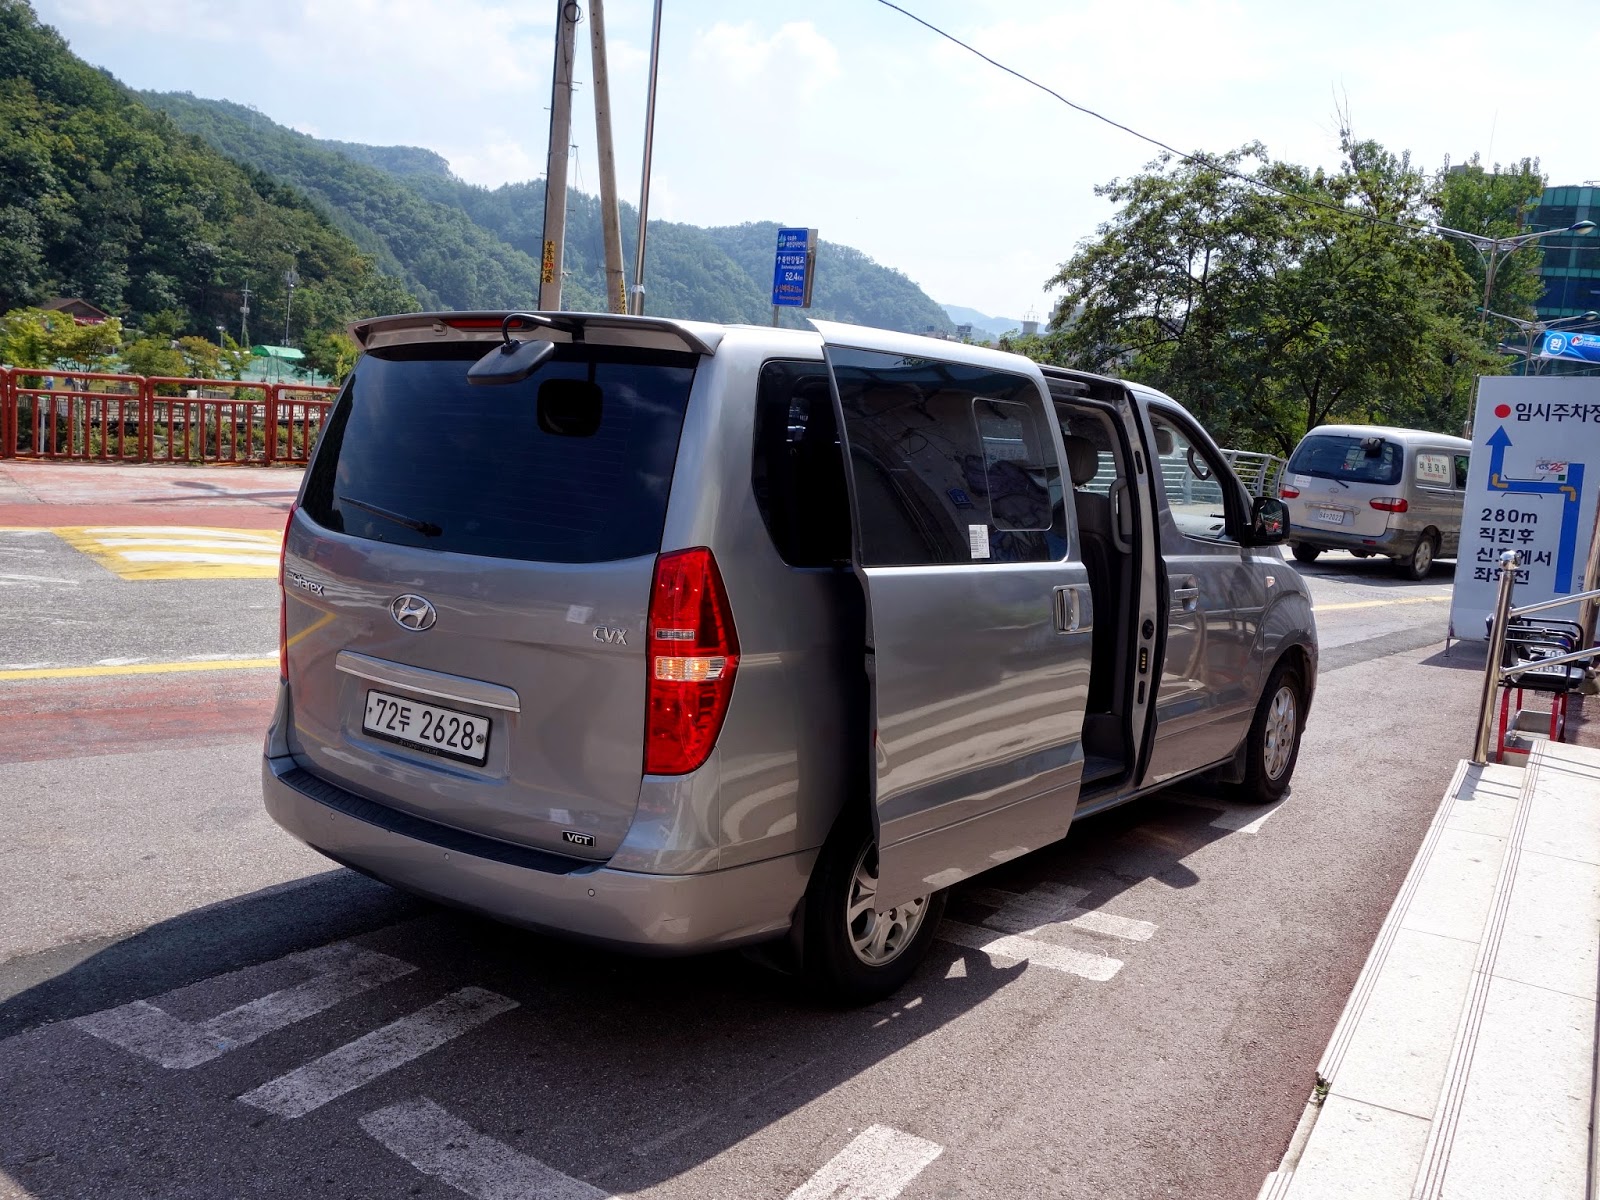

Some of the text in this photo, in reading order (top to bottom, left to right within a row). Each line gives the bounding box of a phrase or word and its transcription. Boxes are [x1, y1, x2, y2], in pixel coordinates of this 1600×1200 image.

[1480, 508, 1539, 525] 280m
[1478, 527, 1536, 545] 직진후
[592, 626, 628, 645] CVX
[375, 698, 412, 732] 72두
[419, 710, 475, 750] 2628
[566, 832, 591, 845] VGT
